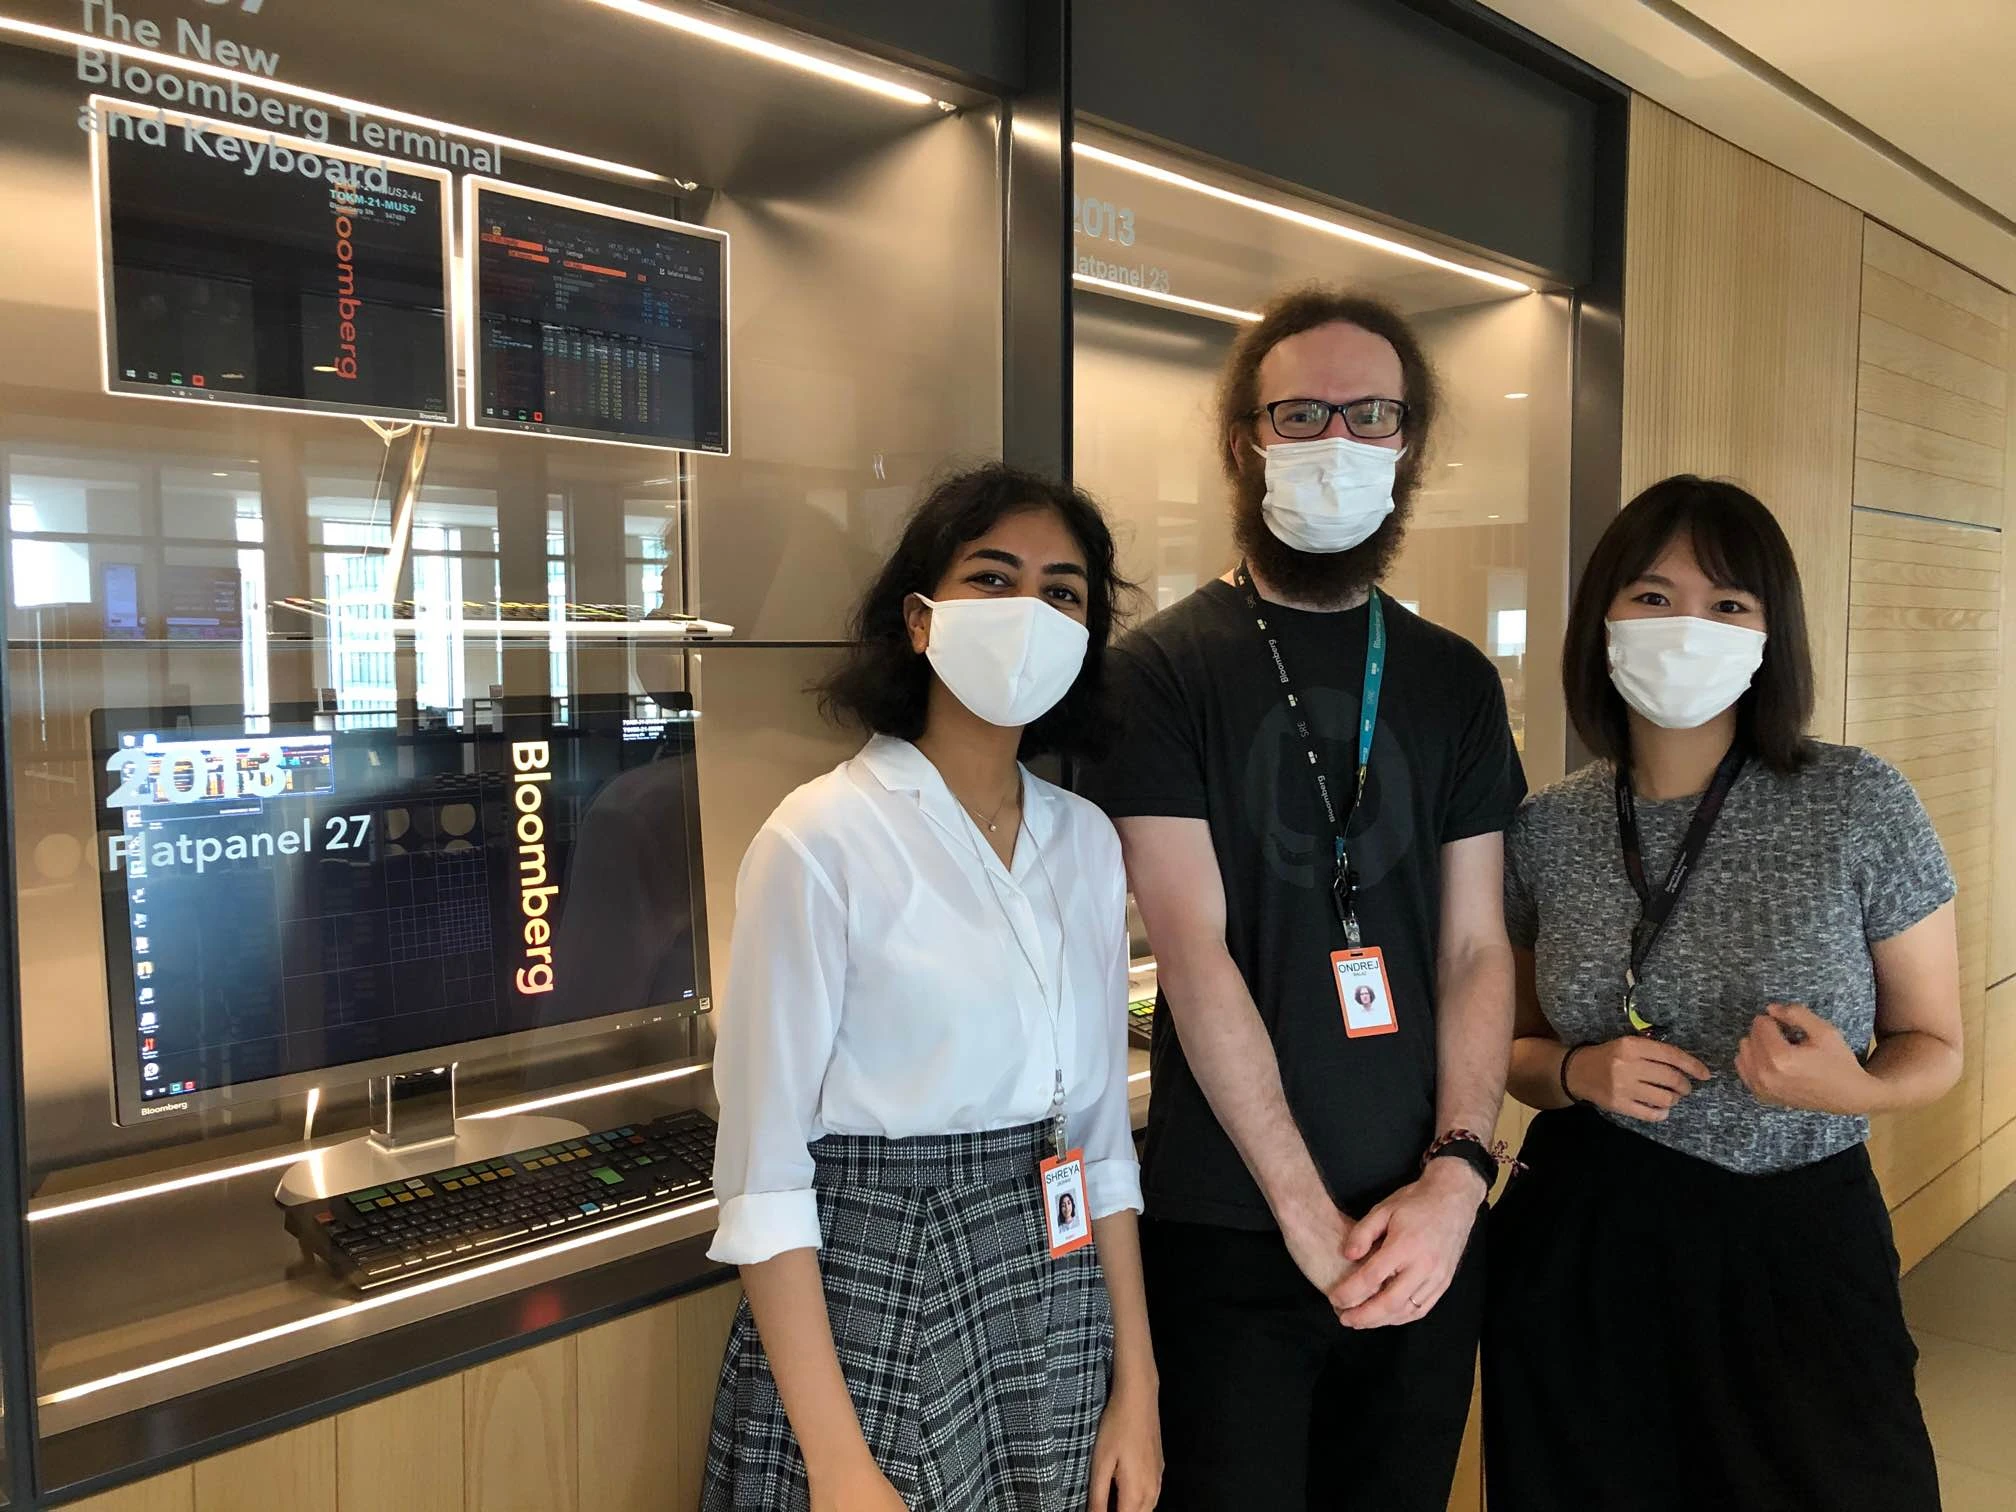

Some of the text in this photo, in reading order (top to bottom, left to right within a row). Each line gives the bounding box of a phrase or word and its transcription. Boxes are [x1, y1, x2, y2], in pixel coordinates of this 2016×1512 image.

[83, 0, 280, 76] The New
[77, 43, 502, 175] Bloomberg Terminal
[77, 104, 388, 193] and Keyboard
[1074, 193, 1136, 247] 013
[1074, 247, 1144, 289] latpanel
[1268, 639, 1289, 683] Bloomberg
[106, 747, 286, 808] 2013
[1317, 775, 1336, 823] Bloomberg
[108, 815, 371, 873] Flatpanel 27
[512, 740, 559, 995] Bloomberg
[1338, 960, 1379, 974] ONDREJ
[141, 1101, 188, 1116] Bloomberg
[1046, 1163, 1080, 1185] SHREYA
